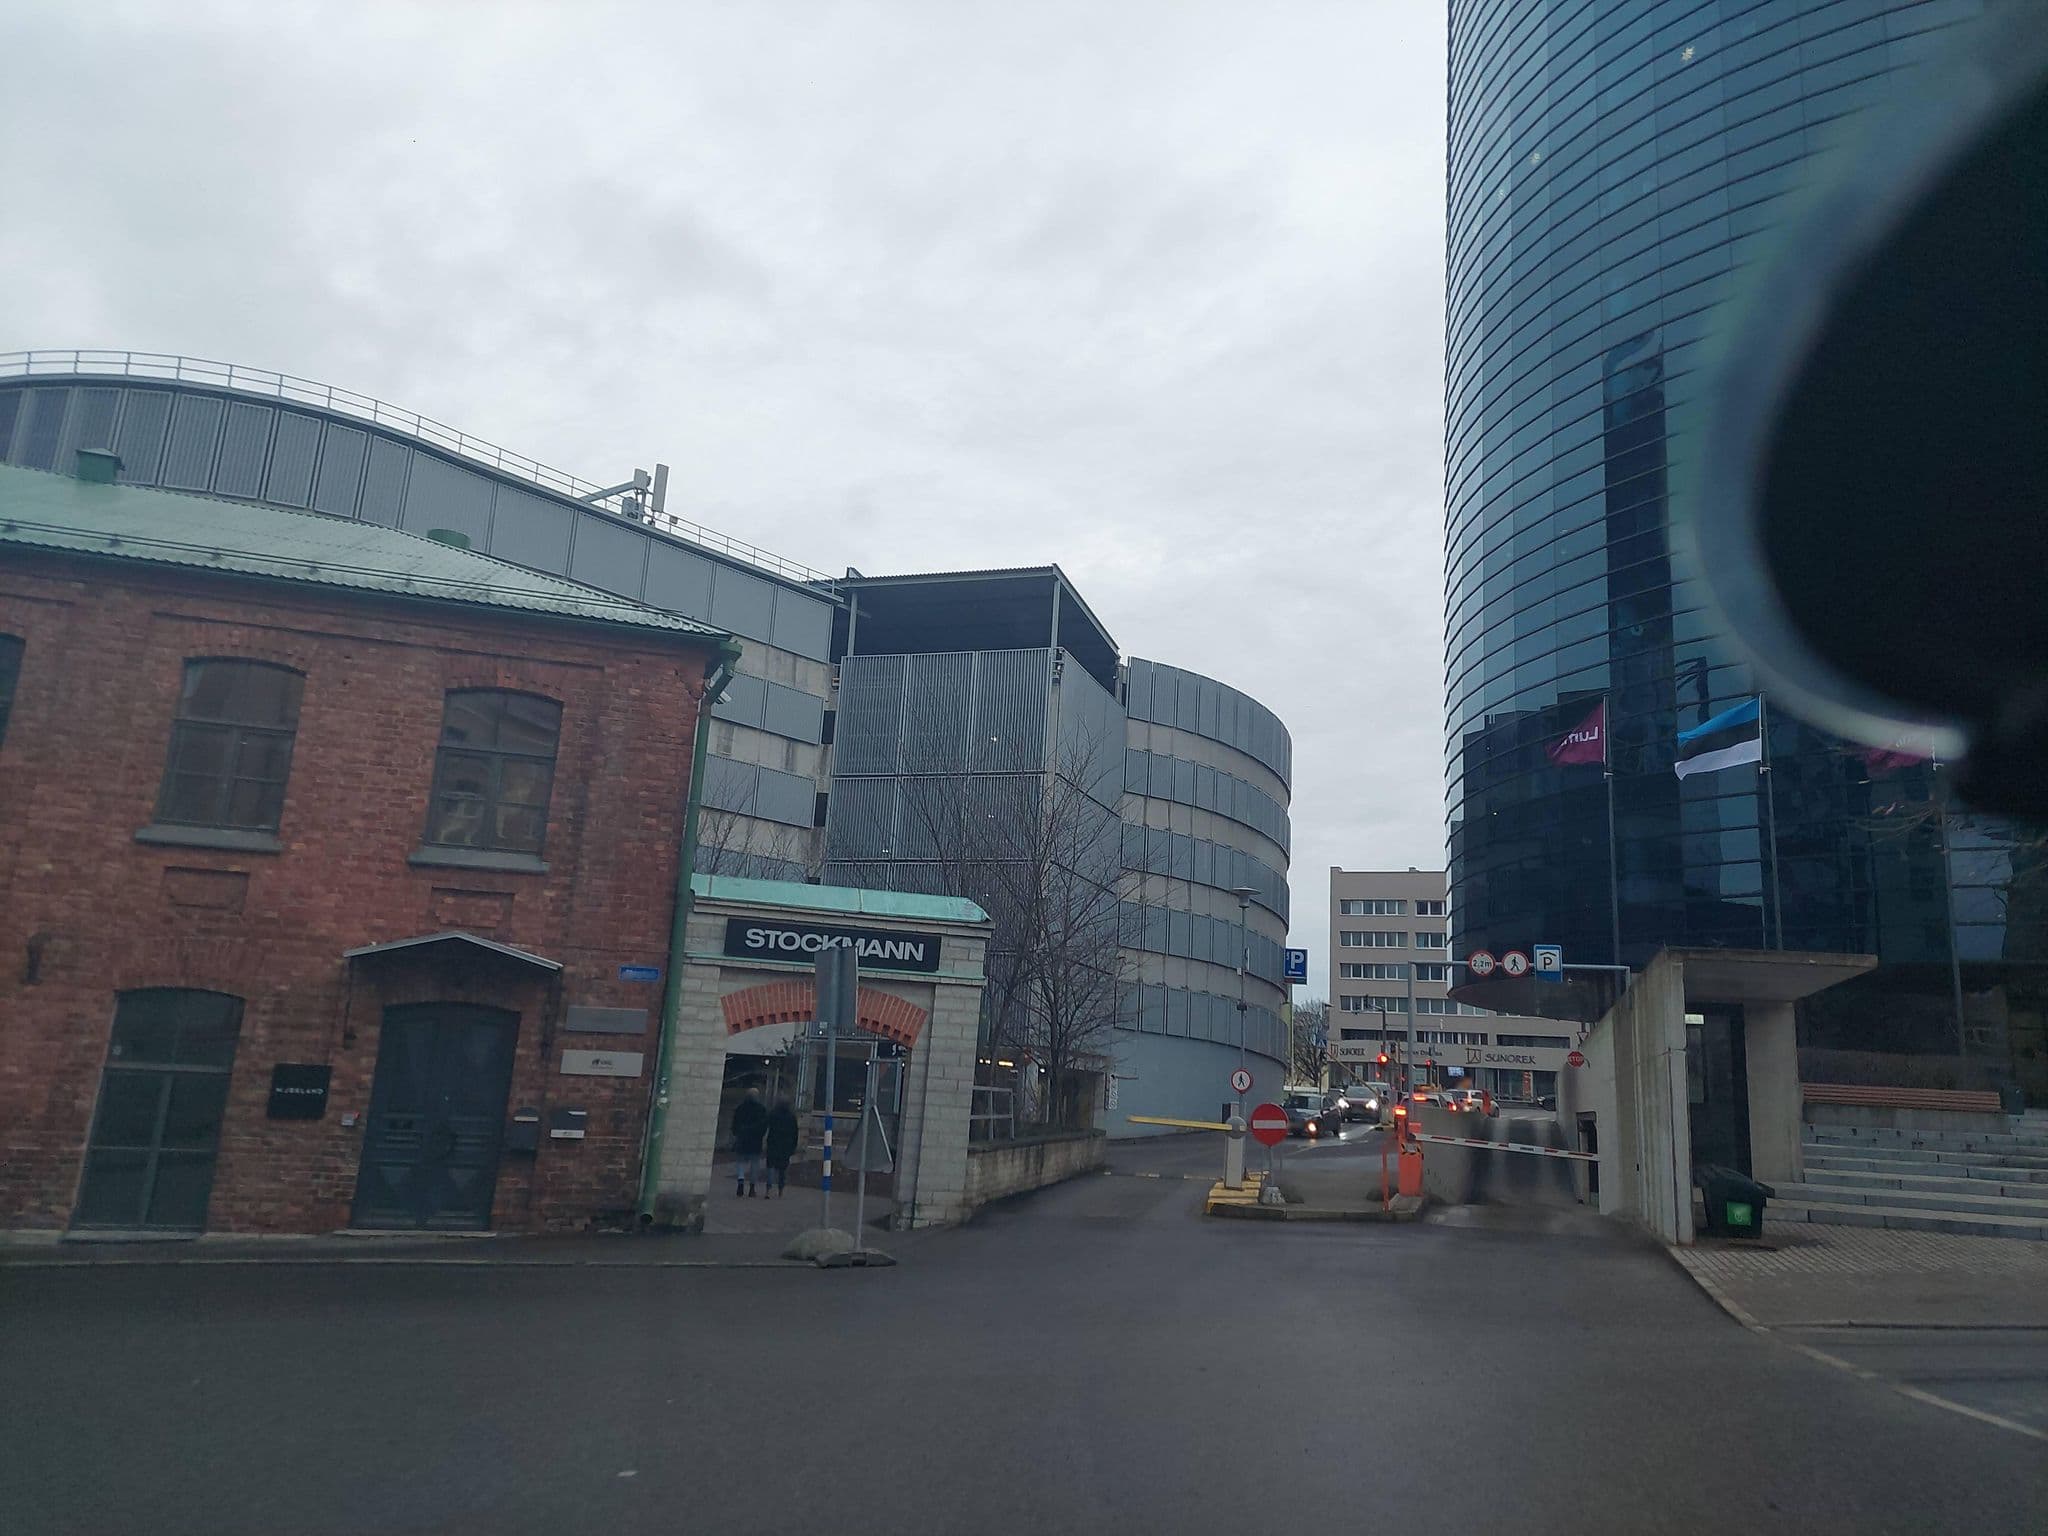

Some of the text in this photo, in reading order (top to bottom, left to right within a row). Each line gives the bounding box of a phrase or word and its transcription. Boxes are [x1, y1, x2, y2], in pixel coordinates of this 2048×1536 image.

[1290, 951, 1305, 970] P
[1542, 957, 1553, 970] P
[1484, 1052, 1537, 1065] SUNOREX
